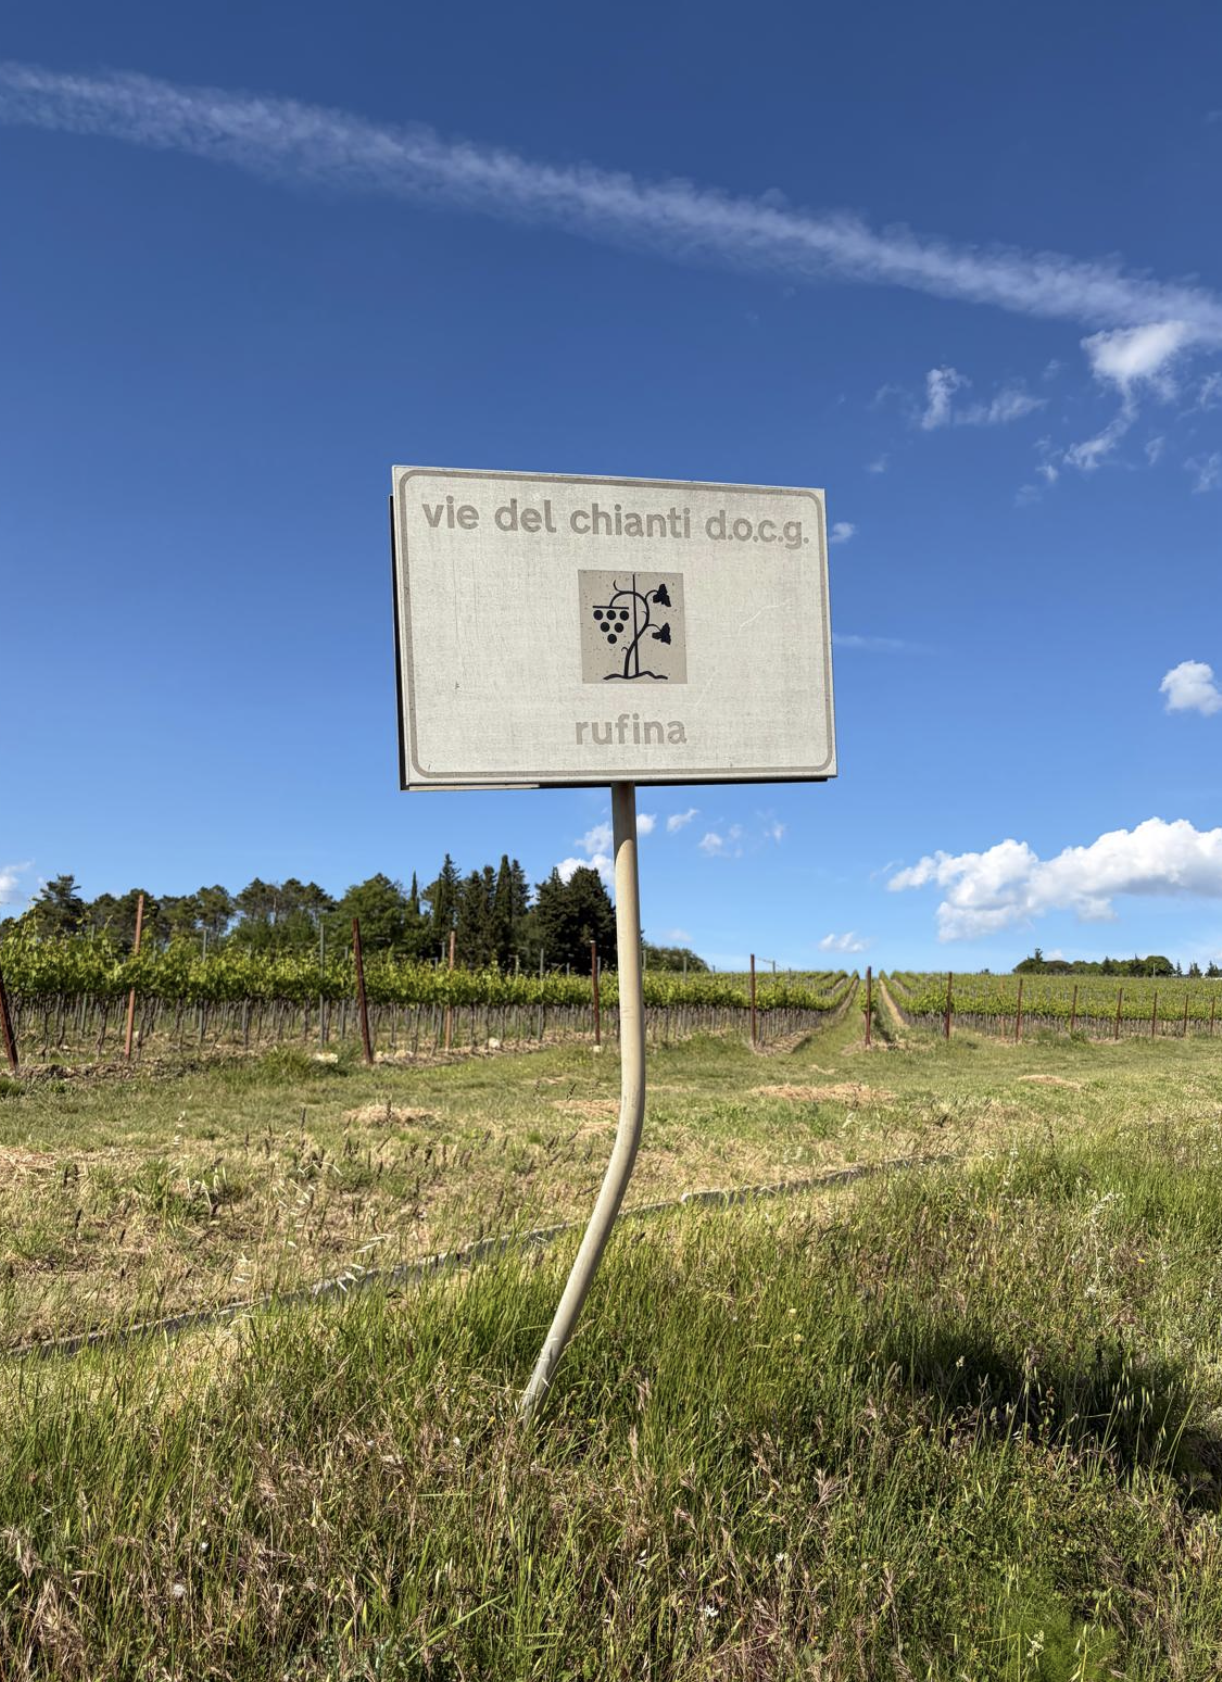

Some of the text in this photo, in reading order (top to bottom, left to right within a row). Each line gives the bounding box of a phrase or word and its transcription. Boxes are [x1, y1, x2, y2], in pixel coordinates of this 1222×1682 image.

[422, 496, 810, 549] vie del chianti d.o.c.g.
[575, 713, 687, 745] rufina
